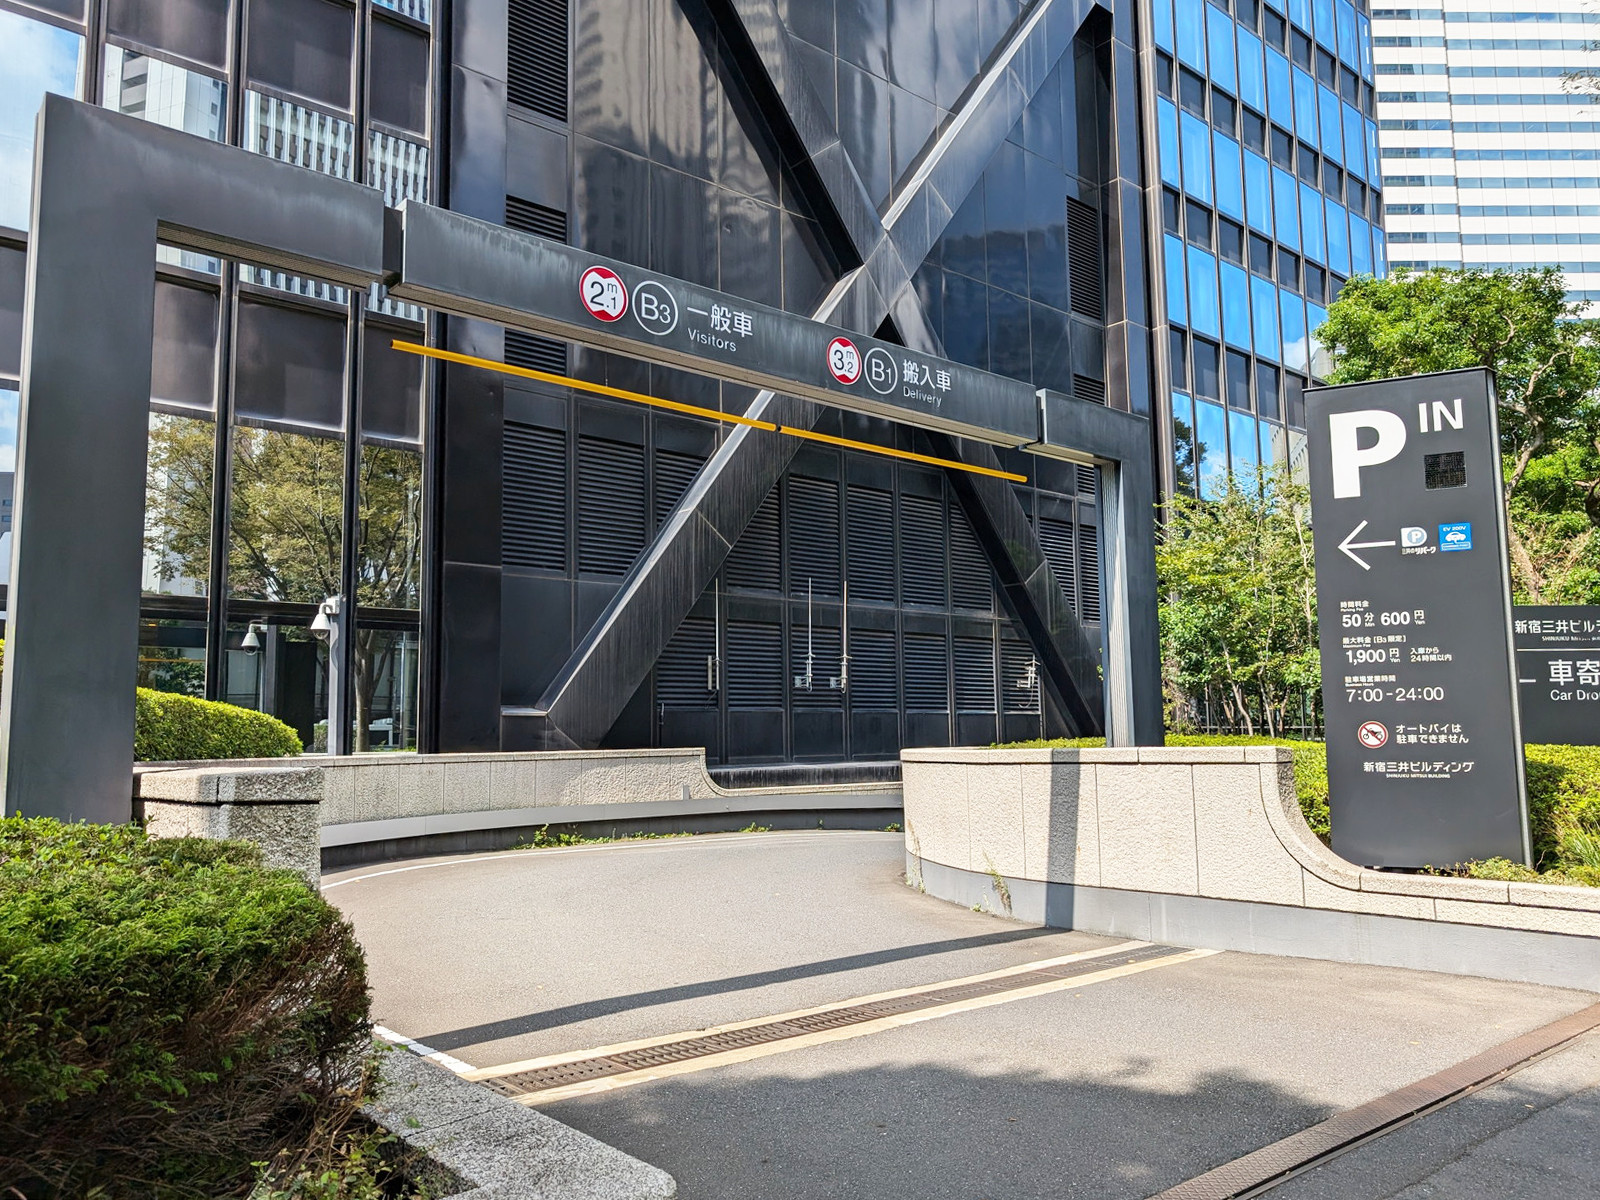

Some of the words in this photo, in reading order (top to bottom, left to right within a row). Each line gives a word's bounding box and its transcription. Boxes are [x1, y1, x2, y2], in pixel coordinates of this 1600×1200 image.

[641, 292, 671, 324] B3
[687, 304, 753, 337] 一般車
[687, 327, 737, 352] Visitors
[871, 358, 892, 384] B1
[902, 359, 952, 392] 搬入車
[903, 386, 942, 407] Delivery
[1418, 398, 1465, 433] IN
[1329, 409, 1407, 499] P
[1342, 614, 1361, 628] 50
[1364, 612, 1374, 622] 分
[1380, 611, 1410, 626] 600
[1413, 609, 1425, 620] 円
[1345, 649, 1386, 666] 1,900
[1389, 648, 1400, 658] 円
[1550, 689, 1573, 701] Car
[1576, 689, 1600, 701] Dro
[1395, 723, 1462, 734] オートバイは
[1396, 734, 1470, 745] 駐車できません
[1363, 761, 1475, 773] 新宿三井ビルディング
